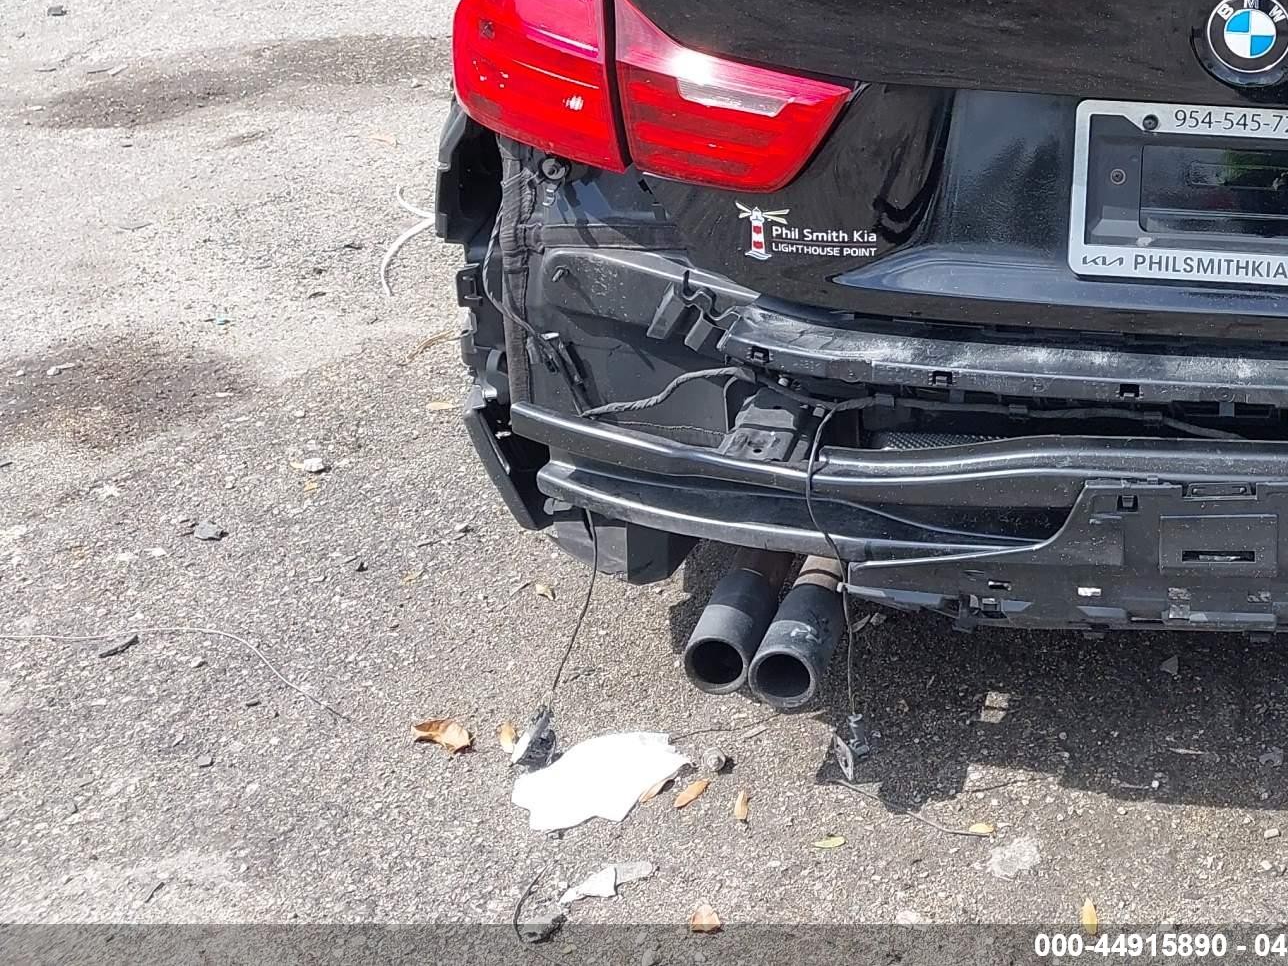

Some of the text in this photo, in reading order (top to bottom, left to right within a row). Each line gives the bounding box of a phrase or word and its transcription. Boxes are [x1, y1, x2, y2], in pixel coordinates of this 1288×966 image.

[772, 225, 877, 242] Phil Smith Kia
[772, 242, 878, 257] LIGHTHOUSE POINT
